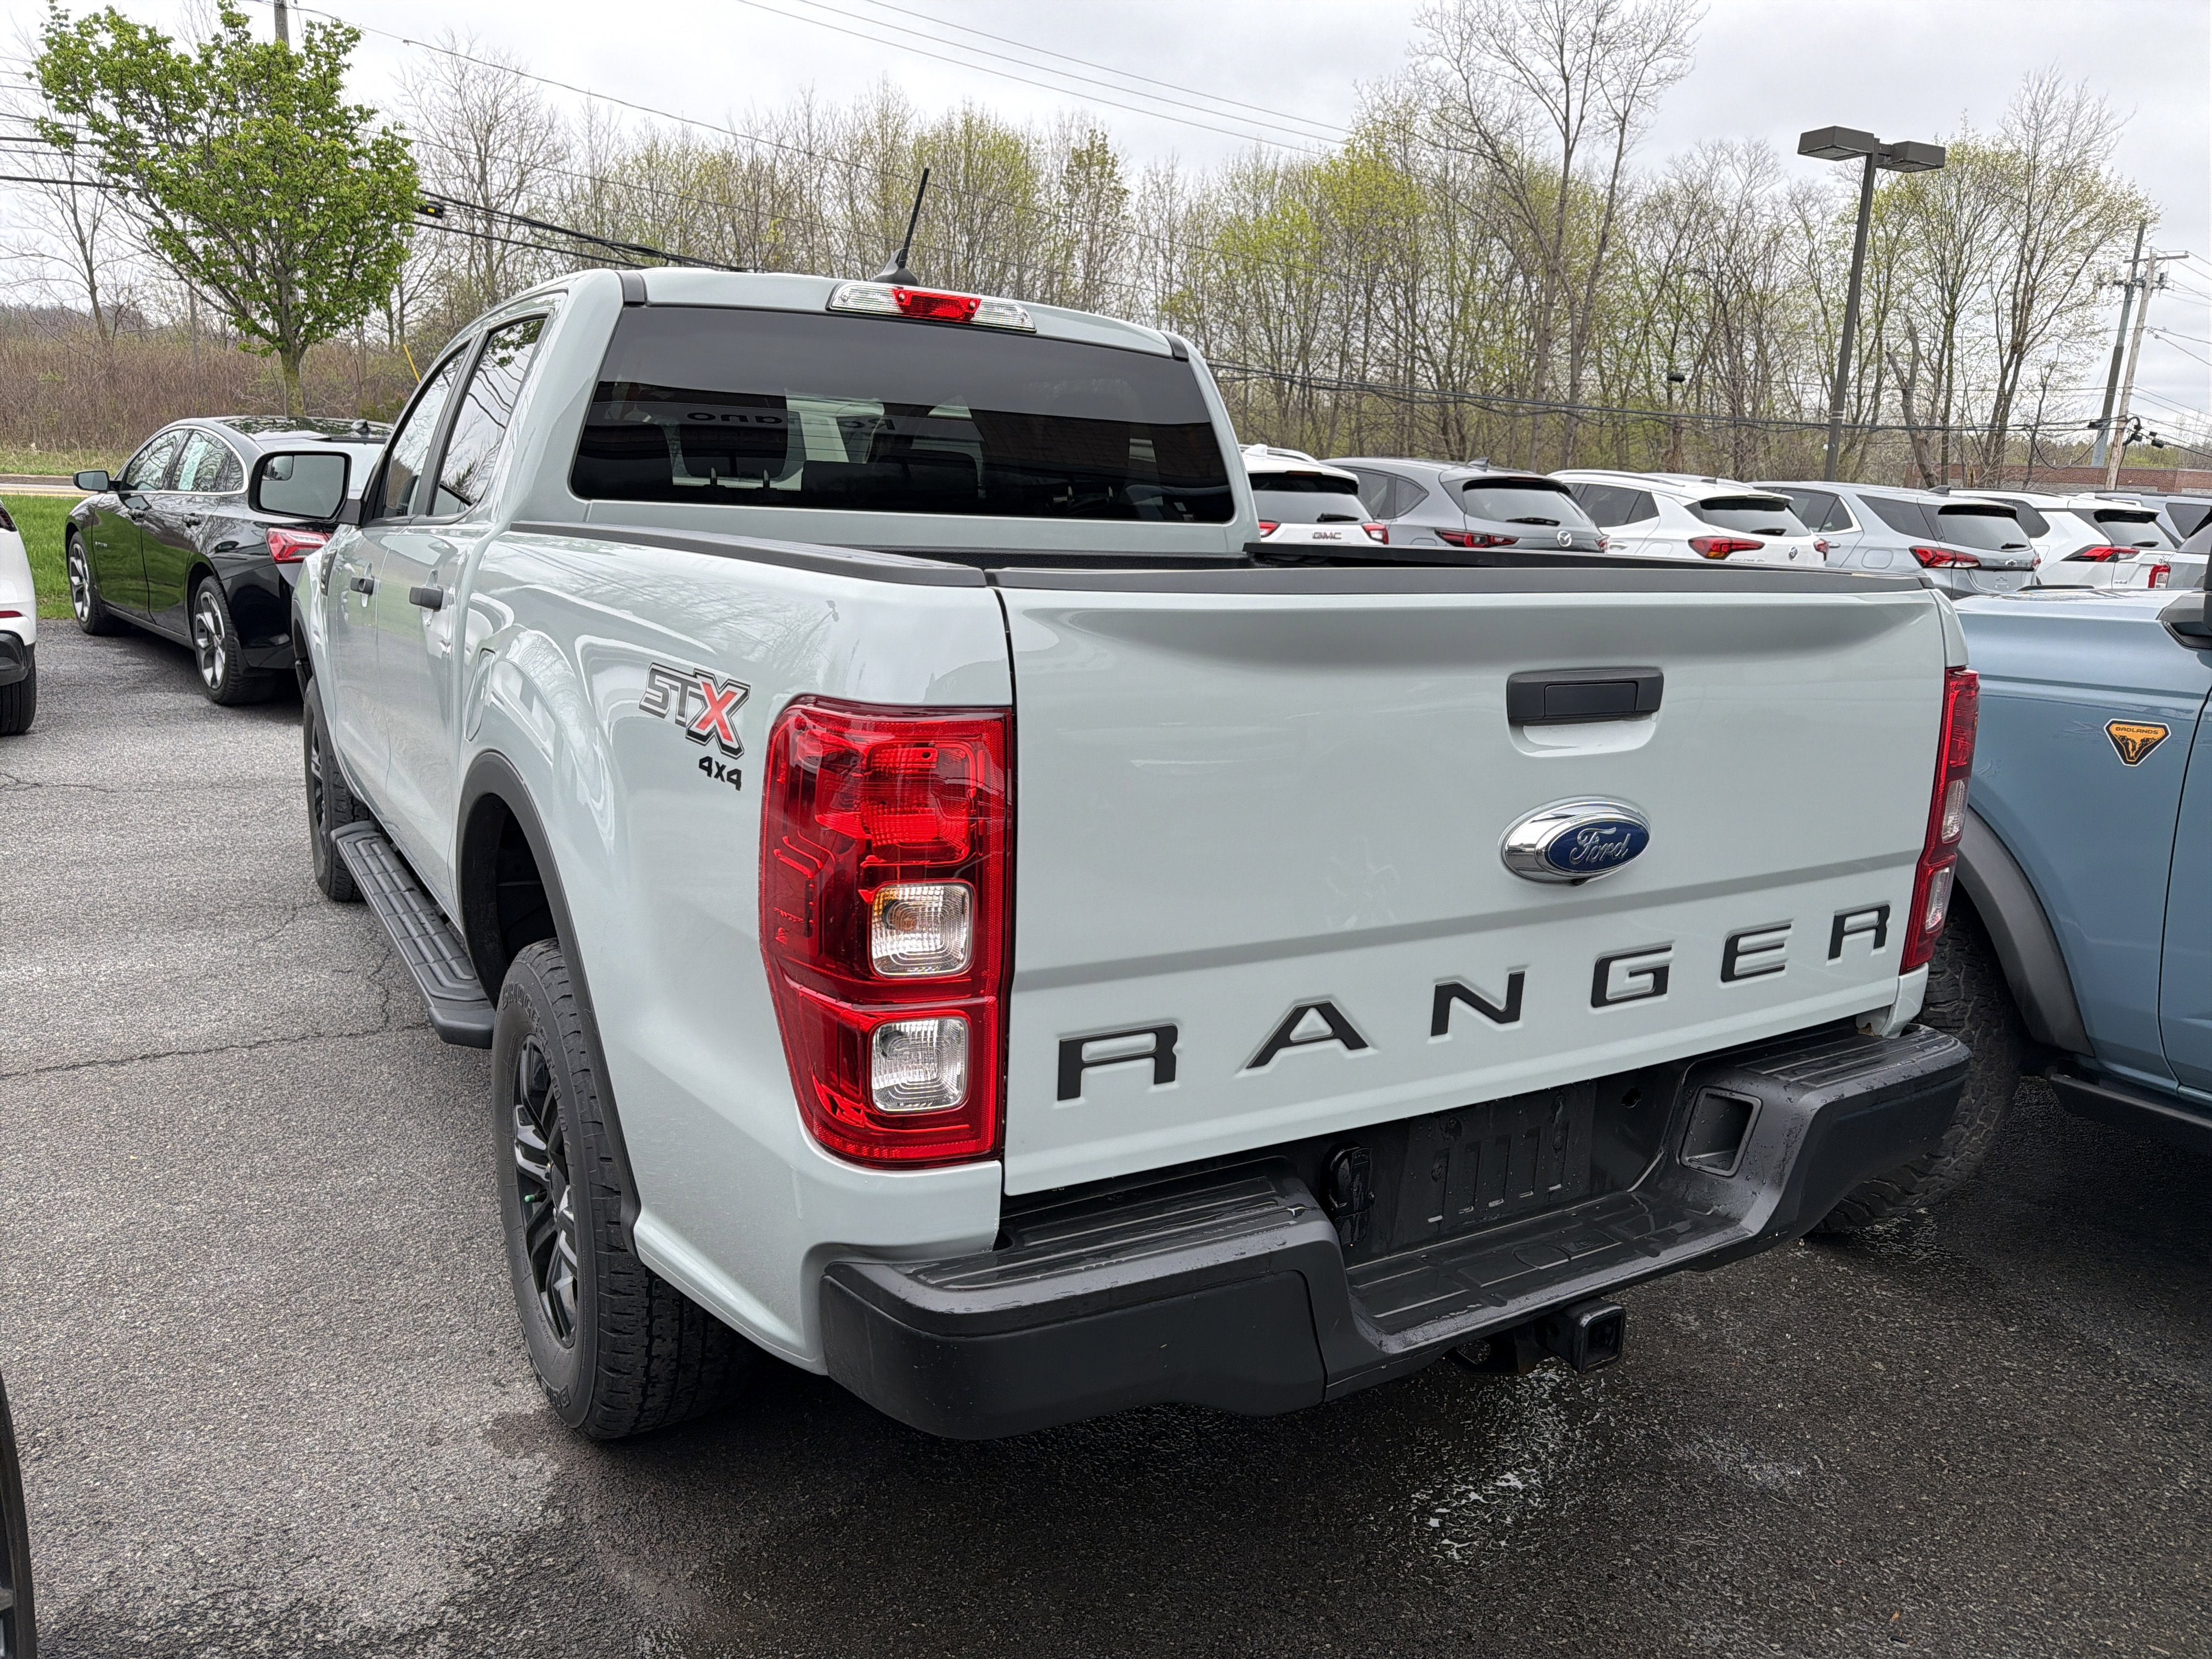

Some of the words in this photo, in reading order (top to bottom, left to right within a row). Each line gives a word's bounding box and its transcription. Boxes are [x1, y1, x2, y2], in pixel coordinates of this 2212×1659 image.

[1312, 531, 1342, 539] GMC
[639, 662, 751, 760] STX
[2115, 726, 2159, 735] BADLANDS
[1568, 826, 1632, 866] Ford
[1057, 903, 1891, 1102] RANGER
